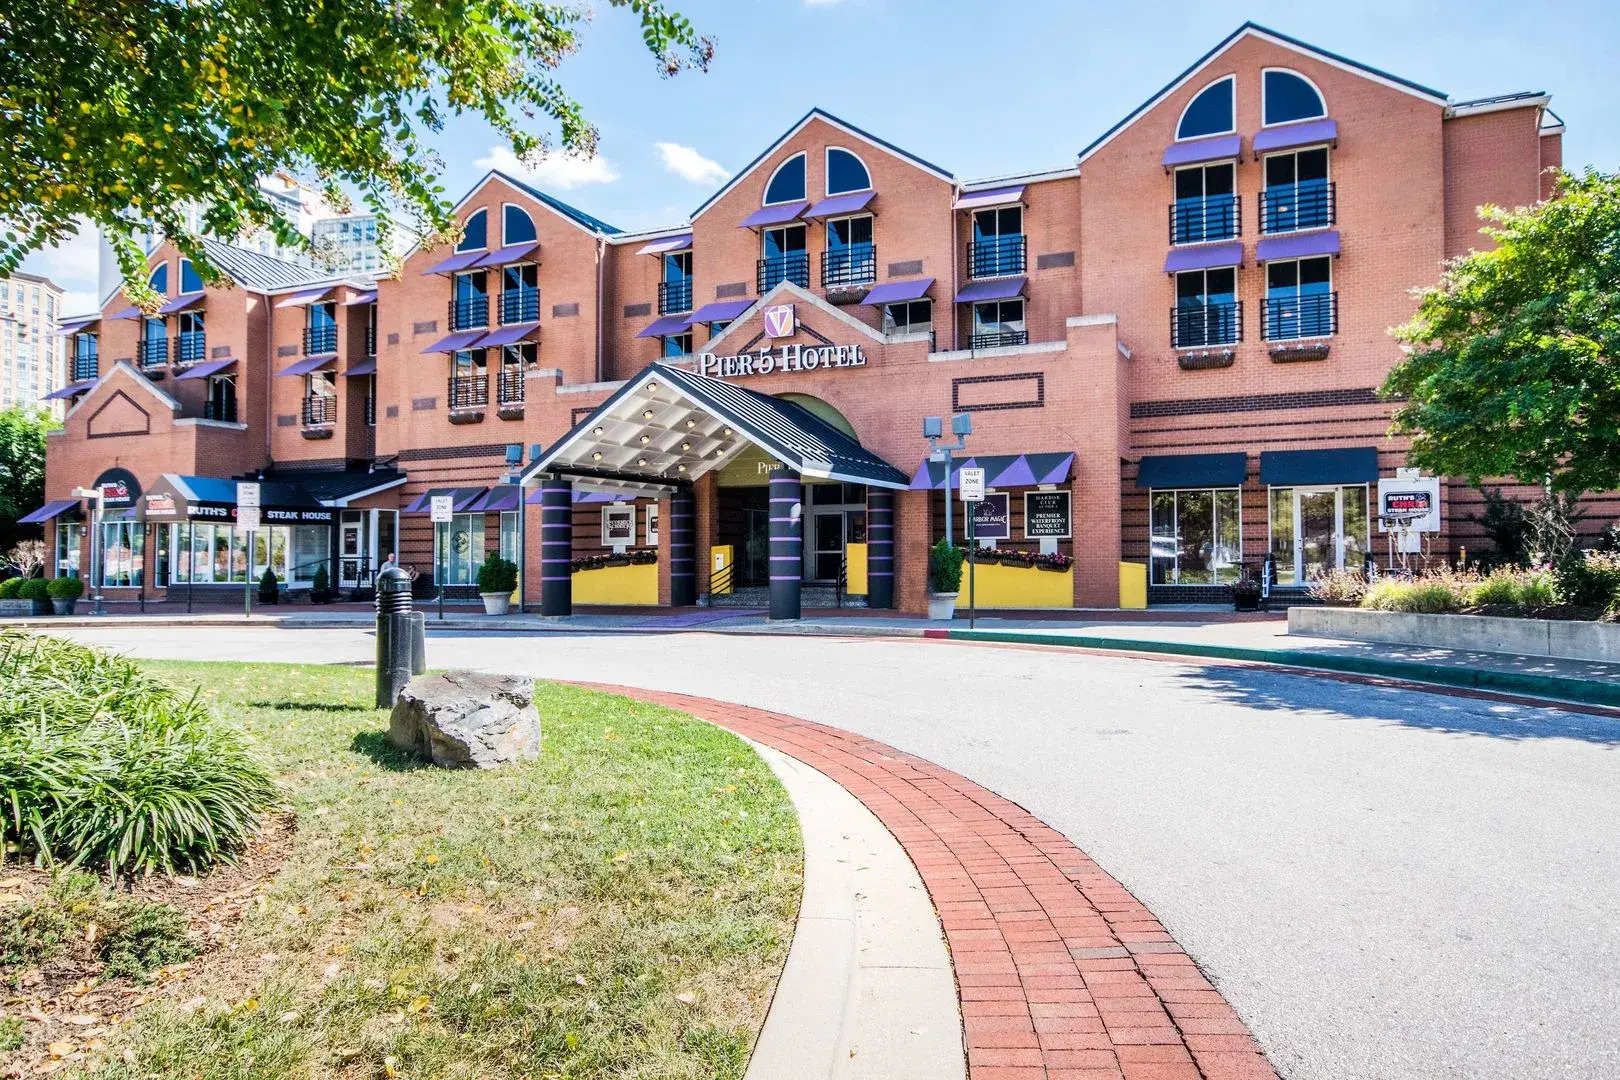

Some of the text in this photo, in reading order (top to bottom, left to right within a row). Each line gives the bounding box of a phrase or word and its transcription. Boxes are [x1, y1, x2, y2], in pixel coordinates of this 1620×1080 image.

[699, 343, 867, 378] PIER 5 HOTEL
[187, 506, 228, 516] RUTH'S
[267, 511, 299, 519] STEAK
[301, 511, 332, 520] HOUSE
[990, 515, 1007, 523] MAGIC
